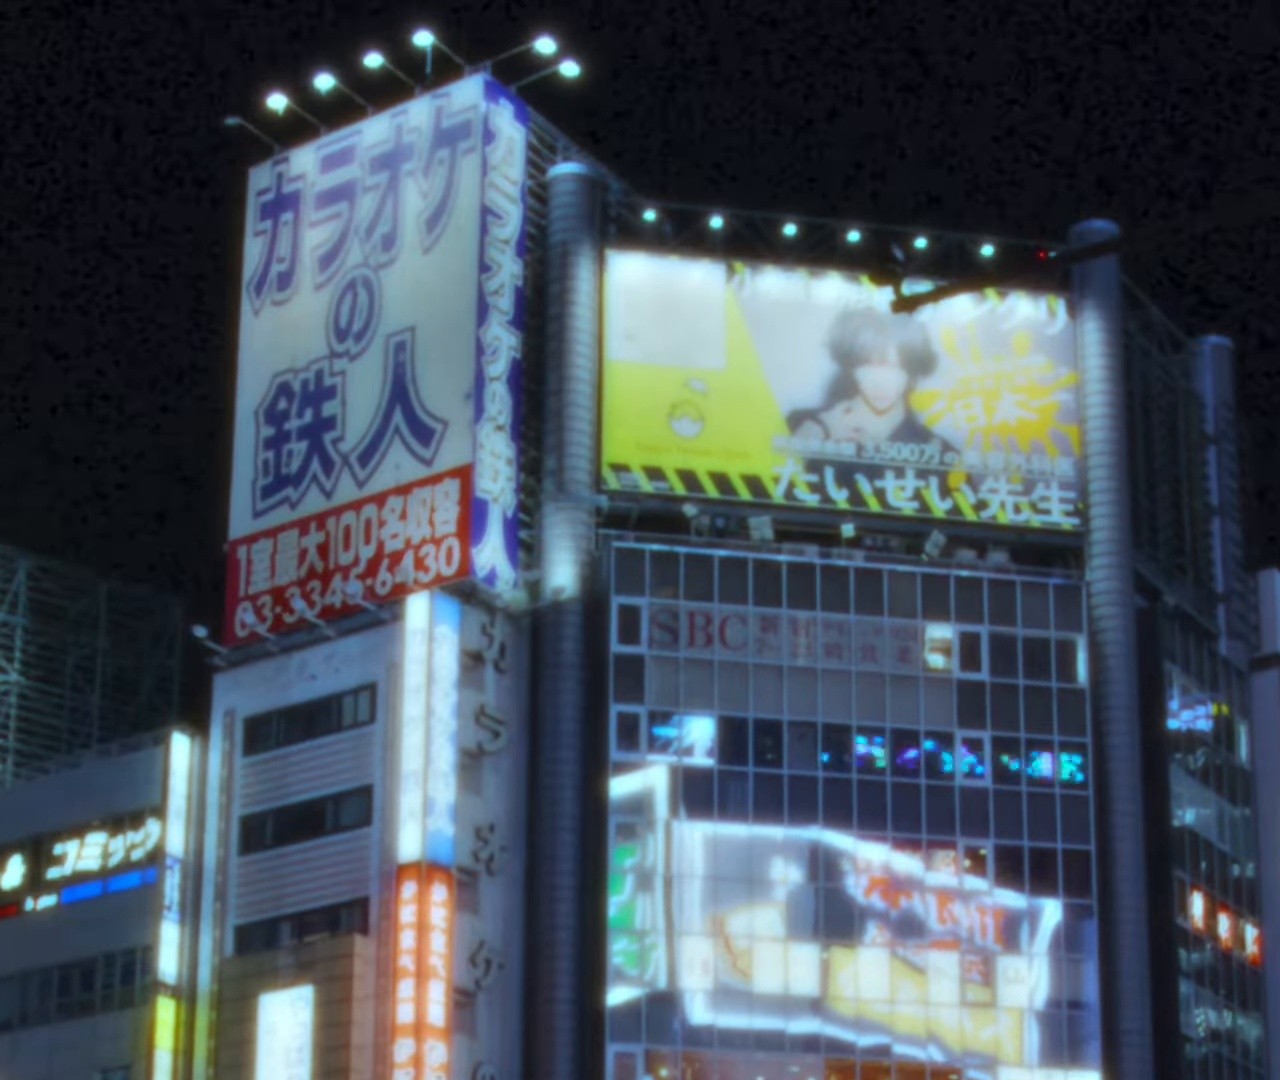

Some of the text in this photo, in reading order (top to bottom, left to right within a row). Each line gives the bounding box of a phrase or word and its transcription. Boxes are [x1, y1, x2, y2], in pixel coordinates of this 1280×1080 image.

[248, 98, 480, 312] カラオケ
[328, 264, 381, 362] の
[252, 328, 448, 519] 鉄人
[773, 458, 1081, 527] たいせい先生
[648, 606, 748, 653] SBC
[45, 816, 162, 881] コミック
